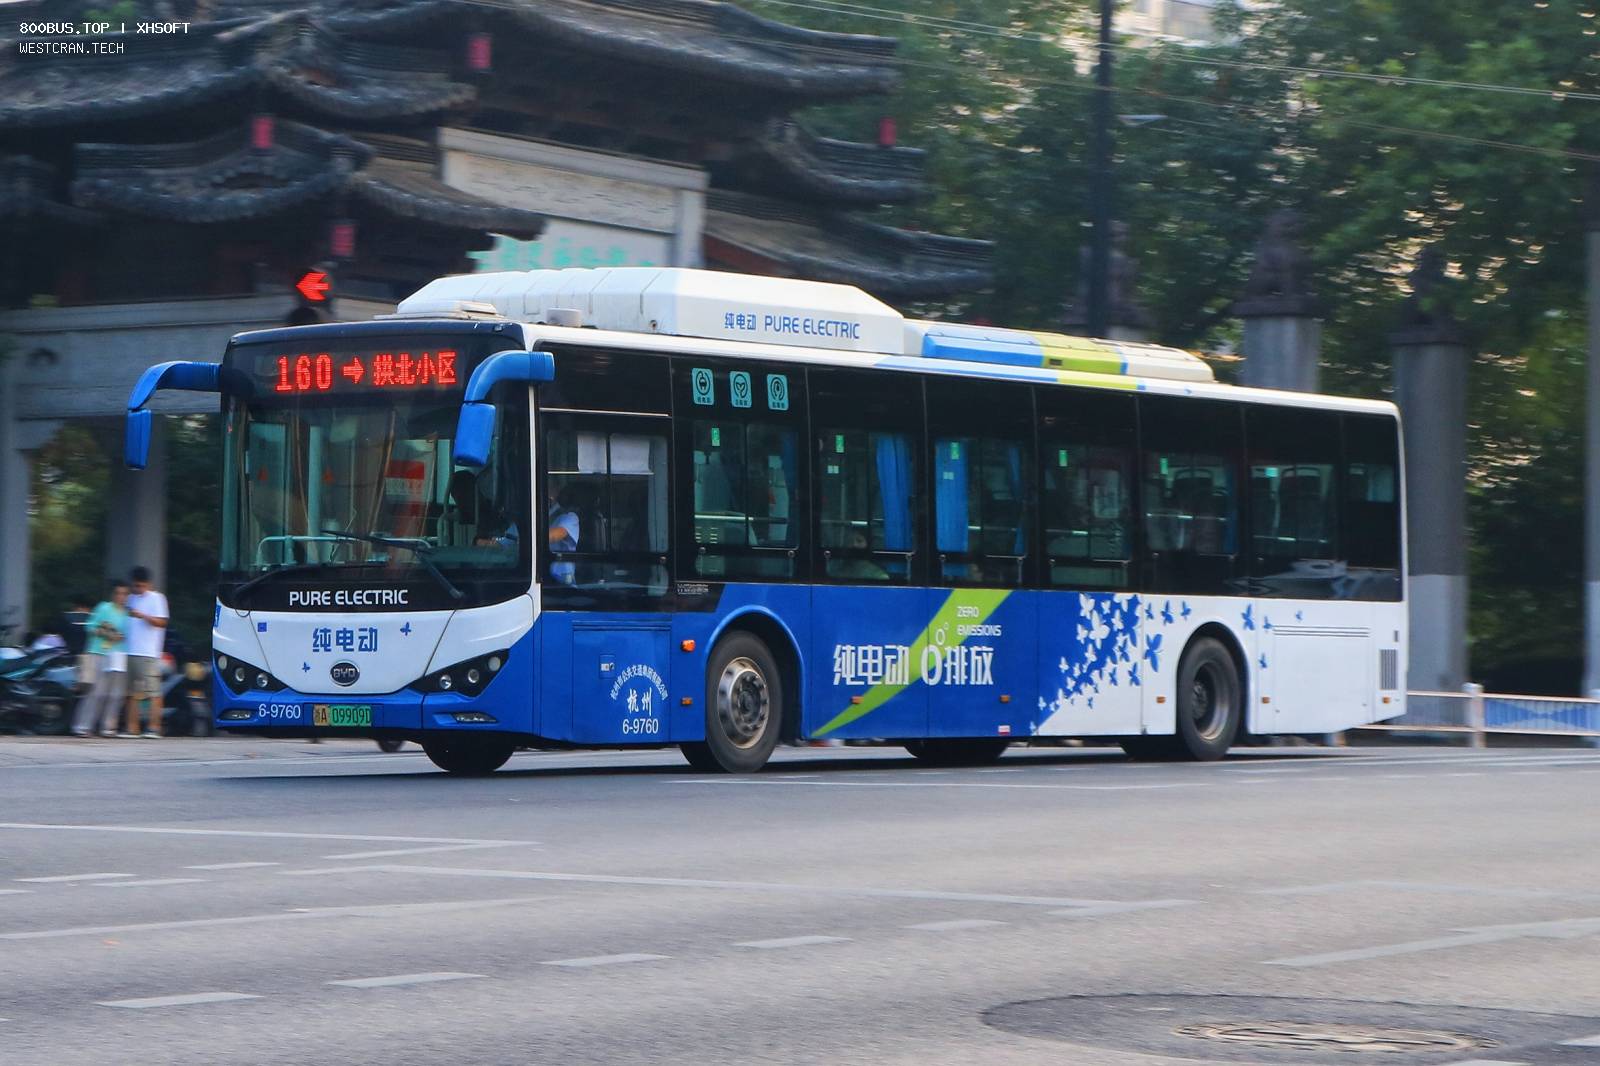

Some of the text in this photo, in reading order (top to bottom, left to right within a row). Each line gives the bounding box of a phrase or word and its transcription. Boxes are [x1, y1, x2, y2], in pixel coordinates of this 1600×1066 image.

[724, 312, 757, 331] 纯电动
[764, 315, 860, 339] PURE ELECTRIC
[276, 354, 332, 391] 160
[373, 351, 456, 386] 拱北小区
[289, 589, 409, 606] PURE ELECTRIC
[957, 606, 979, 618] ZERO
[312, 627, 379, 653] 纯电动
[332, 668, 356, 679] BYD
[833, 645, 910, 686] 纯电动
[258, 704, 301, 720] 6-9760
[627, 687, 652, 716] 杭州
[622, 718, 659, 735] 6-9760
